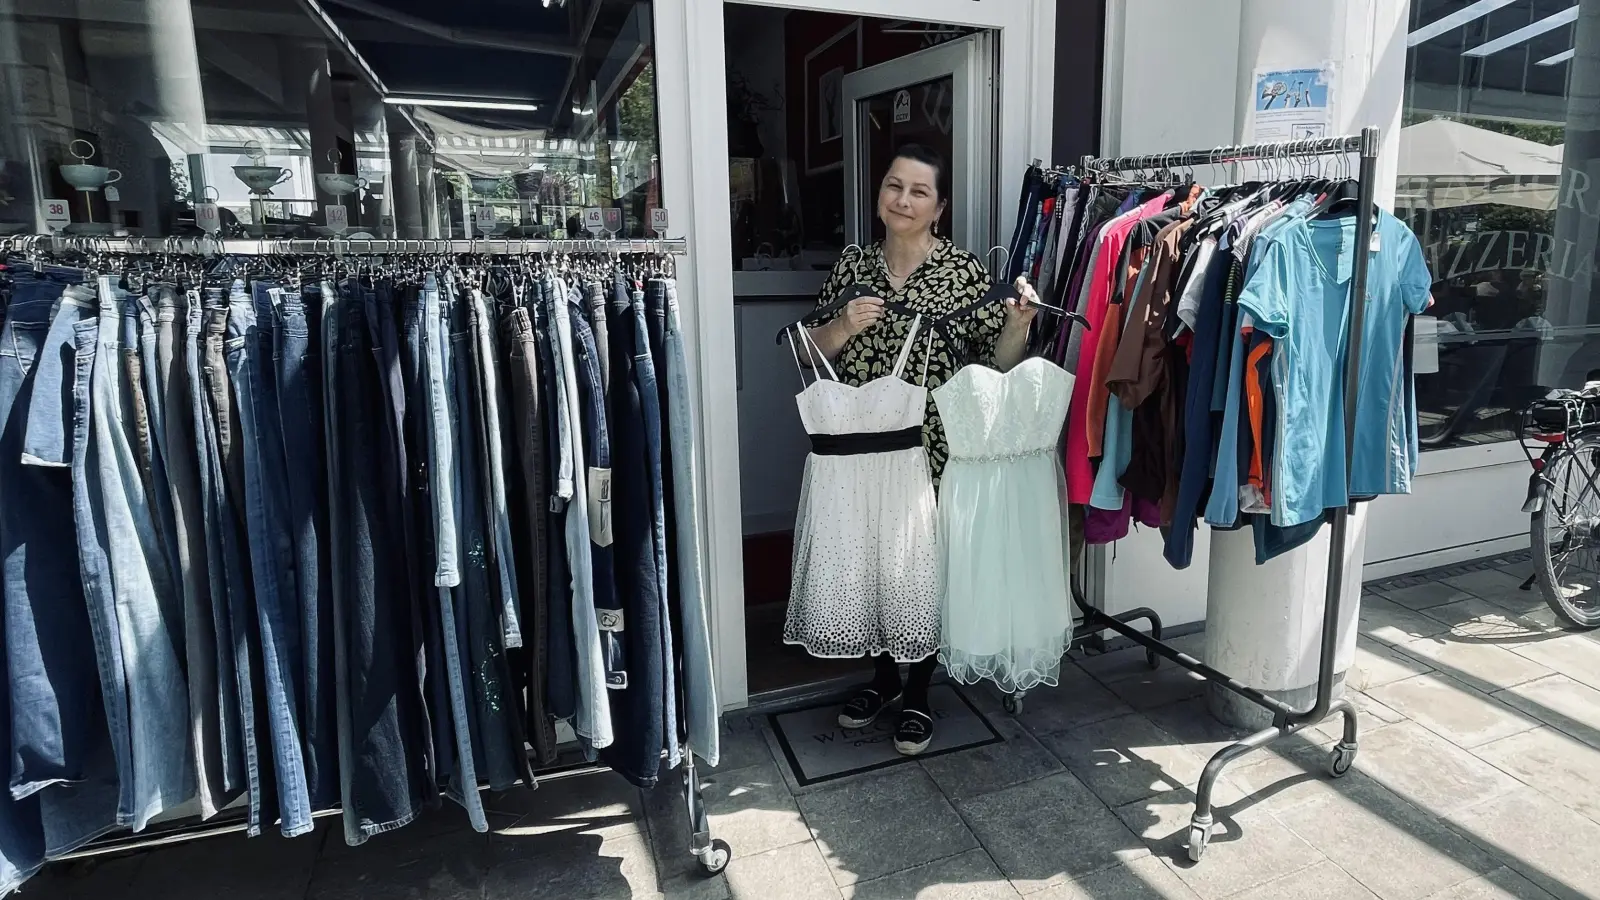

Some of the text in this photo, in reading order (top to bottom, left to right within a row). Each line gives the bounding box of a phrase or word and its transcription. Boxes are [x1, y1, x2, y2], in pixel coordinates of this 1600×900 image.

[48, 203, 64, 215] 38
[479, 209, 491, 221] 44
[589, 211, 600, 222] 46
[654, 211, 666, 222] 50
[1425, 231, 1597, 284] IZZERIA
